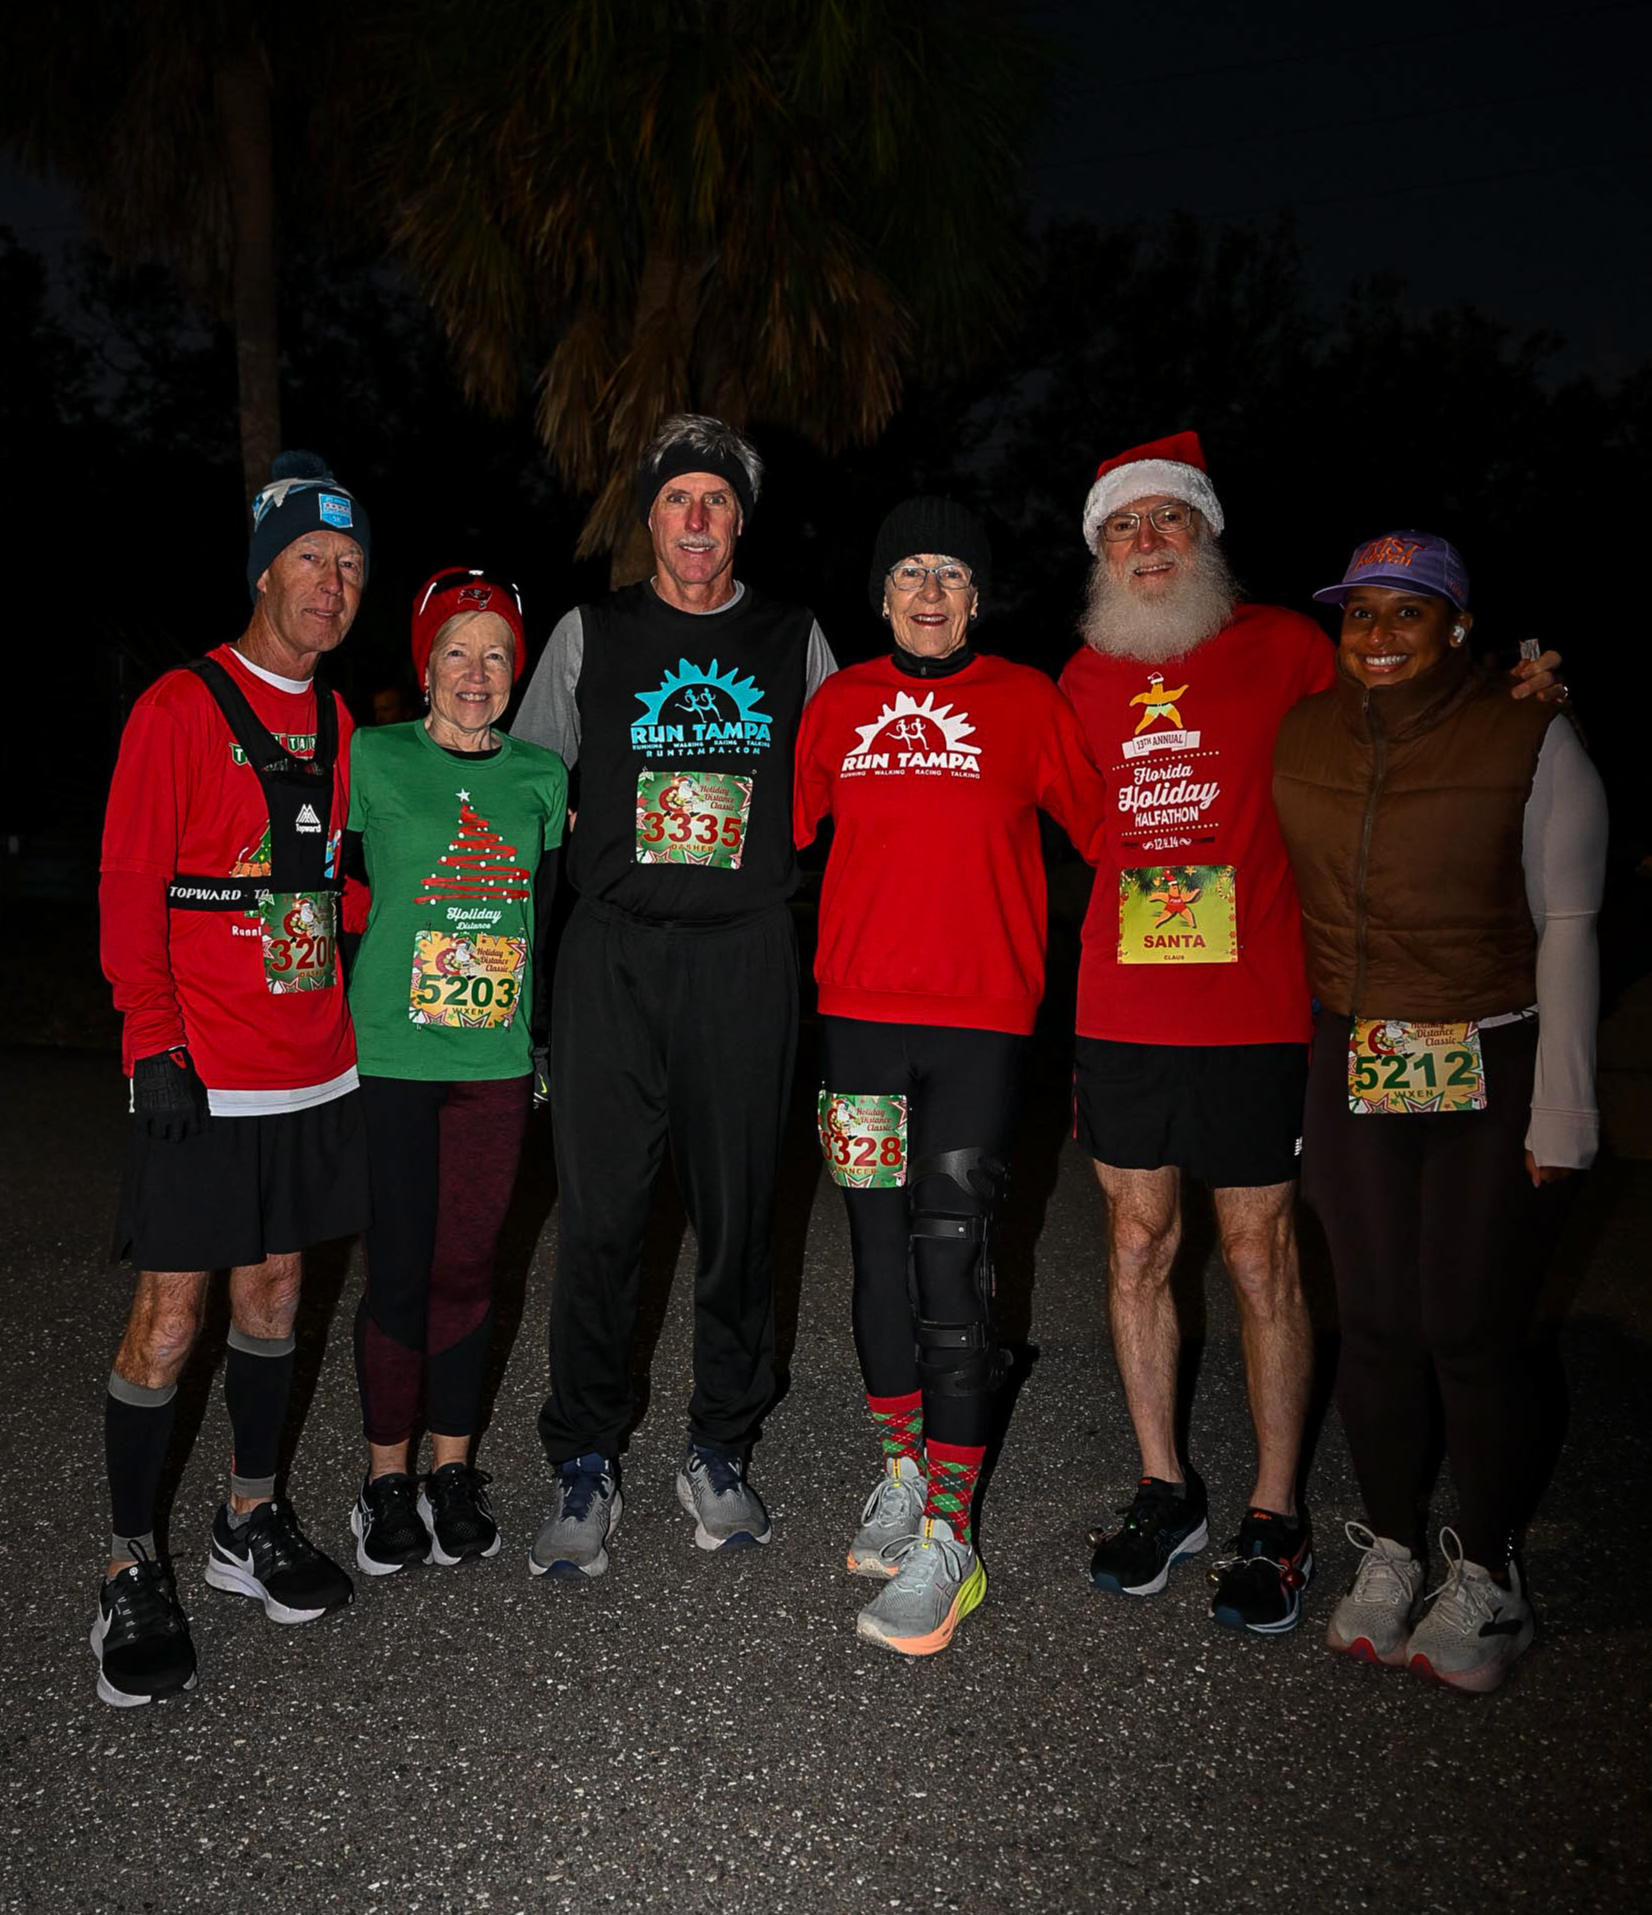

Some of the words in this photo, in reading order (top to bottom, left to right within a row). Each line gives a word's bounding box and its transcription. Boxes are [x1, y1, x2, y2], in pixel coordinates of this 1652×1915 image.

[630, 724, 684, 744] RUN
[692, 722, 771, 742] TAMPA
[746, 740, 771, 748] TALKING
[1136, 738, 1151, 750] 13TH
[1152, 733, 1183, 746] ANNUAL
[646, 747, 761, 758] RUNTAMPA.COM
[841, 753, 890, 772] RUN
[897, 752, 980, 772] TAMPA
[840, 770, 867, 779] RUNNING
[950, 770, 981, 779] TALKING
[1133, 763, 1194, 785] Florida
[1118, 780, 1221, 814] Holiday
[710, 801, 735, 811] Classic
[1135, 805, 1199, 828] HALFATHON
[295, 823, 322, 834] Topward
[642, 811, 742, 848] 3335
[671, 843, 714, 852] DASHER
[169, 886, 242, 900] TOPWARD
[446, 907, 502, 924] Holiday
[456, 921, 492, 930] Distance
[1143, 934, 1206, 949] SANTA
[476, 947, 504, 958] Holiday
[480, 956, 509, 965] Distance
[485, 964, 509, 973] Classic
[416, 974, 516, 1008] 5203
[452, 1007, 484, 1015] VIXEN
[1415, 1028, 1455, 1039] Distance
[1425, 1036, 1457, 1047] Classic
[1354, 1051, 1476, 1090] 5212
[1394, 1089, 1435, 1098] VIXEN
[821, 1131, 902, 1166] 3328
